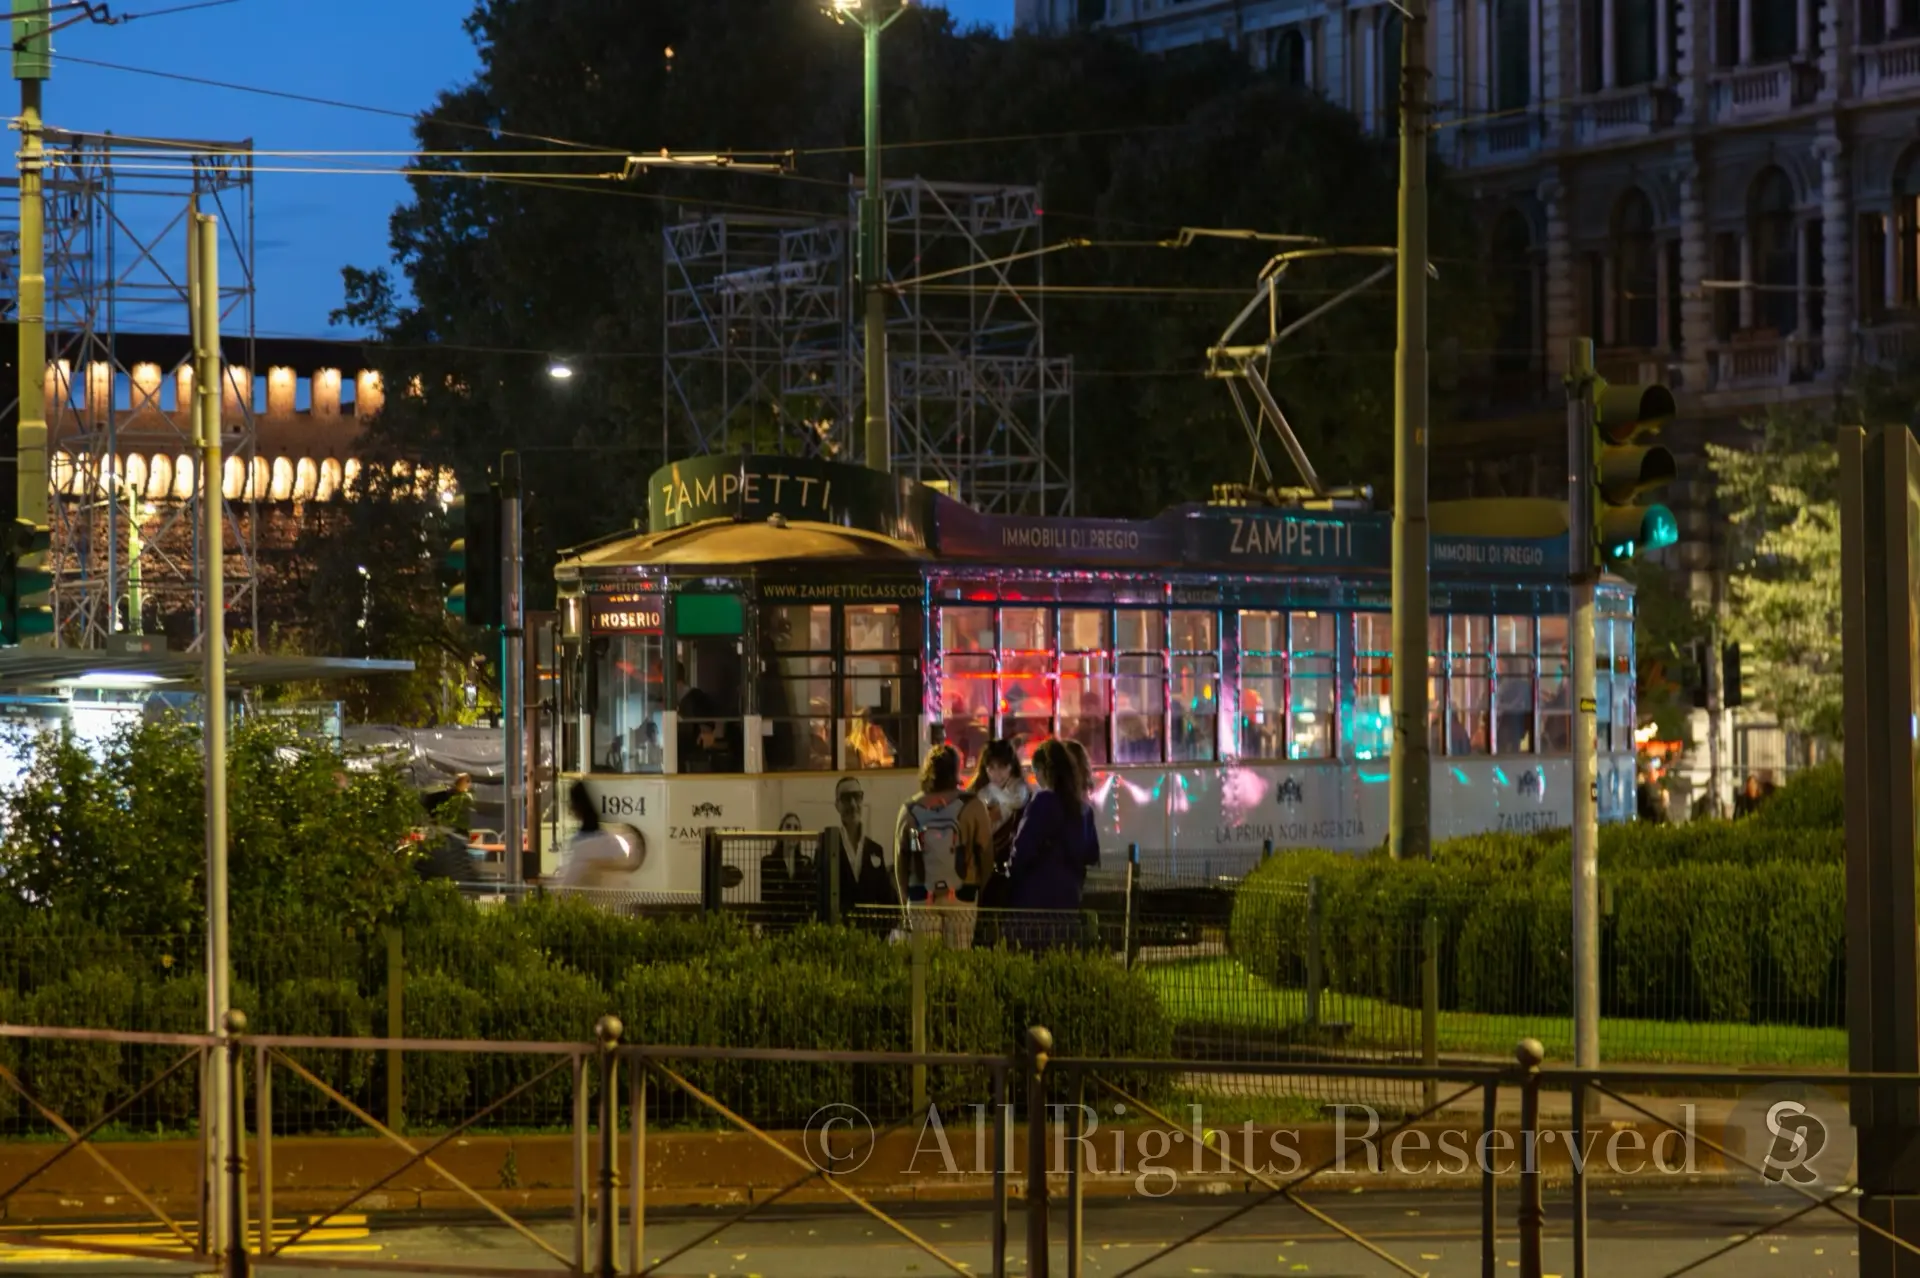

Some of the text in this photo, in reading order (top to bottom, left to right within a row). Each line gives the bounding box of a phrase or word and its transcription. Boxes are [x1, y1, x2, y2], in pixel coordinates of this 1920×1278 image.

[662, 474, 831, 516] ZAMPETTI
[1002, 527, 1139, 550] IMMOBILI DI PREGIO
[1229, 517, 1352, 557] ZAMPETTI
[1434, 543, 1543, 566] IMMOBILI DI PREGIO
[600, 611, 661, 628] ROSERIO
[602, 795, 646, 817] 1984
[1216, 818, 1365, 844] LA PRIMA NON AGENZIA
